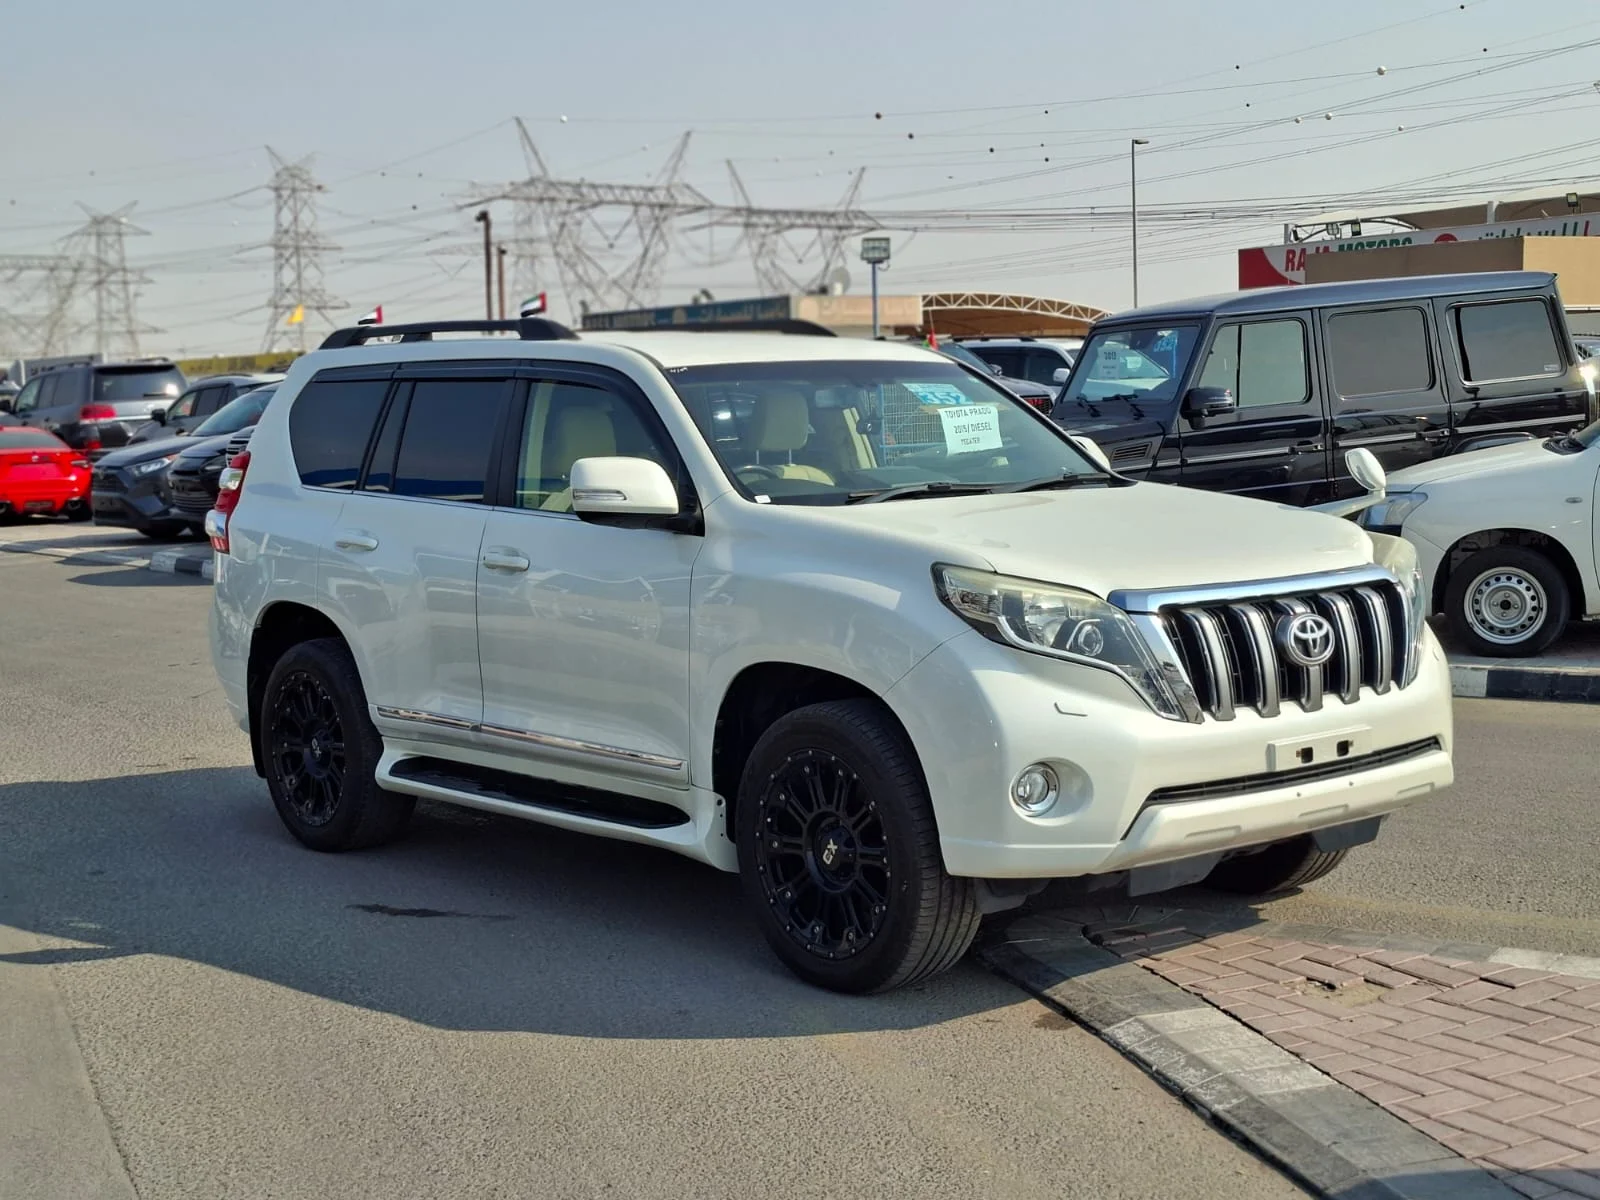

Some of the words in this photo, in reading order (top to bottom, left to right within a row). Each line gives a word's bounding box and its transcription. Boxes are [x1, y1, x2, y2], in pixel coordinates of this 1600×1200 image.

[944, 409, 969, 418] TOYOTA
[969, 407, 992, 416] PRADO
[970, 421, 993, 432] DIESEL
